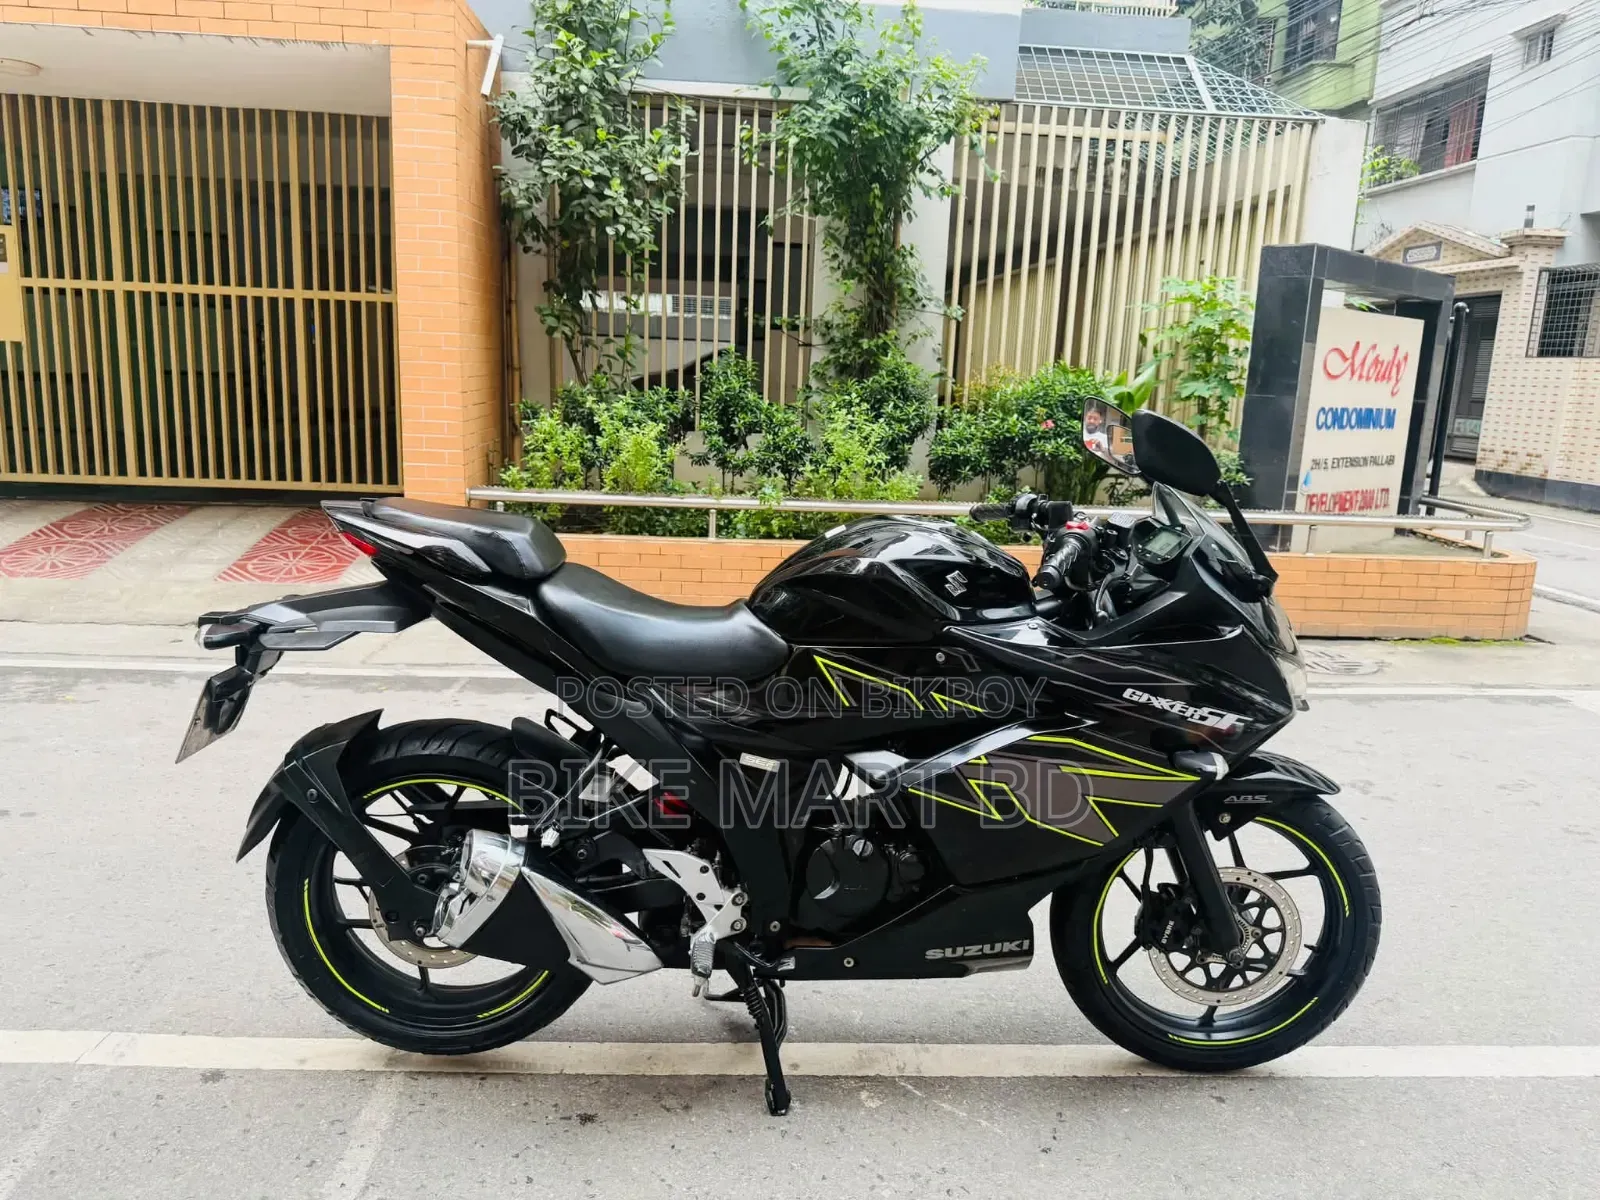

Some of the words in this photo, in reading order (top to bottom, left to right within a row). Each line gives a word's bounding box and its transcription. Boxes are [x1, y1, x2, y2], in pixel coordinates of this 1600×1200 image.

[1323, 341, 1408, 397] Mouly
[1316, 407, 1396, 430] CONDOMINIUM
[1331, 456, 1368, 469] EXTENSION
[925, 939, 1030, 959] SUZUKI
